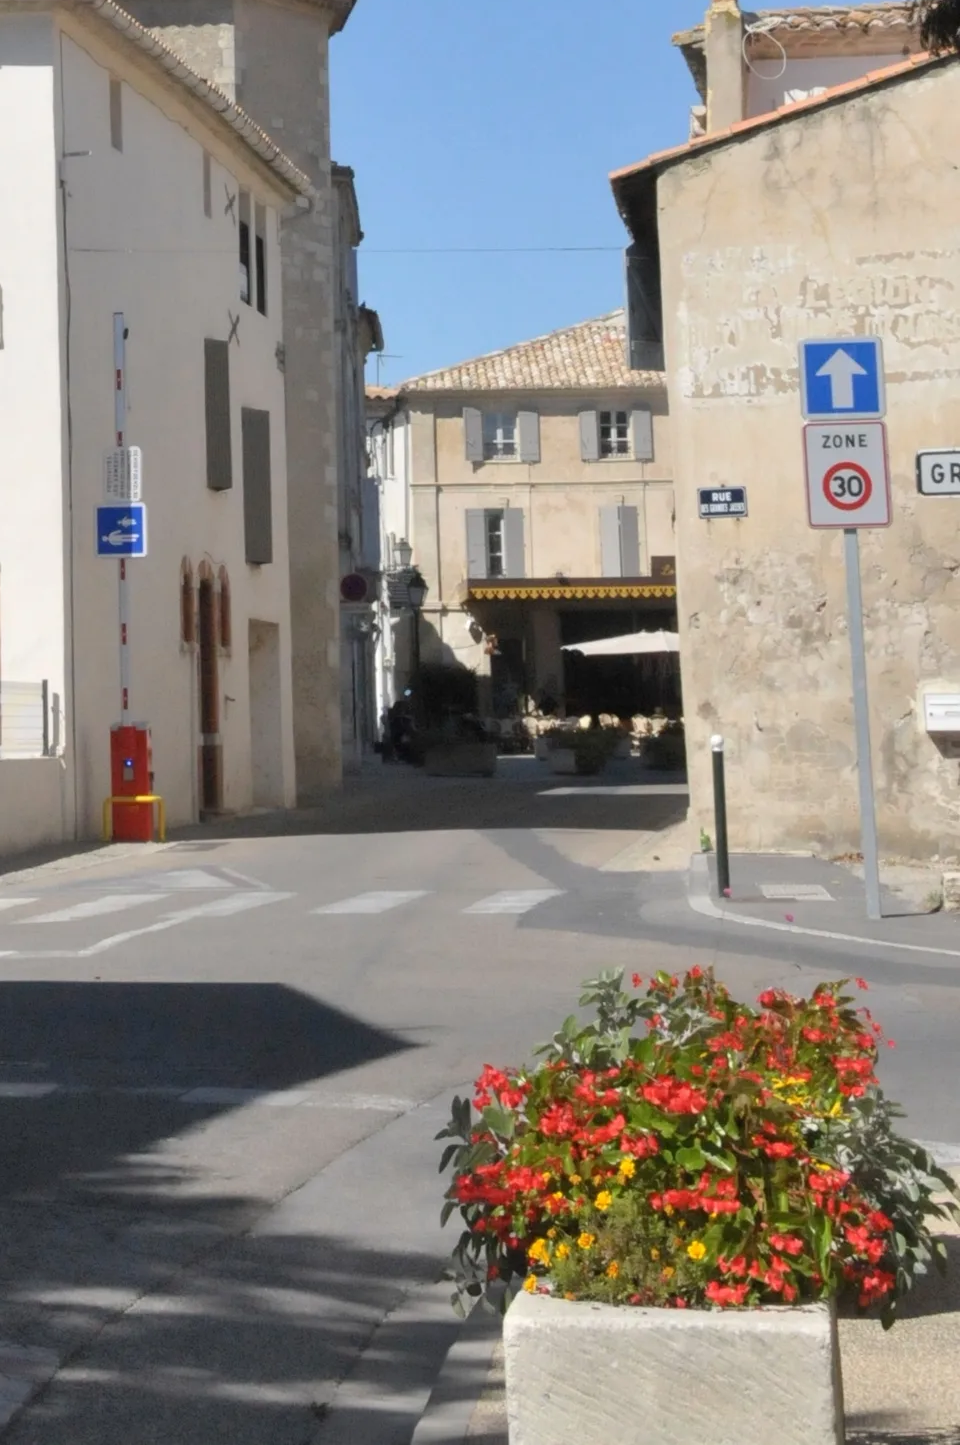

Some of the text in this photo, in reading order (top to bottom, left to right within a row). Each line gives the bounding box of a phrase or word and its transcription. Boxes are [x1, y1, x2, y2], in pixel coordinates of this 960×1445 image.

[821, 434, 868, 449] ZONE
[832, 475, 863, 498] 30
[711, 491, 732, 502] RUE
